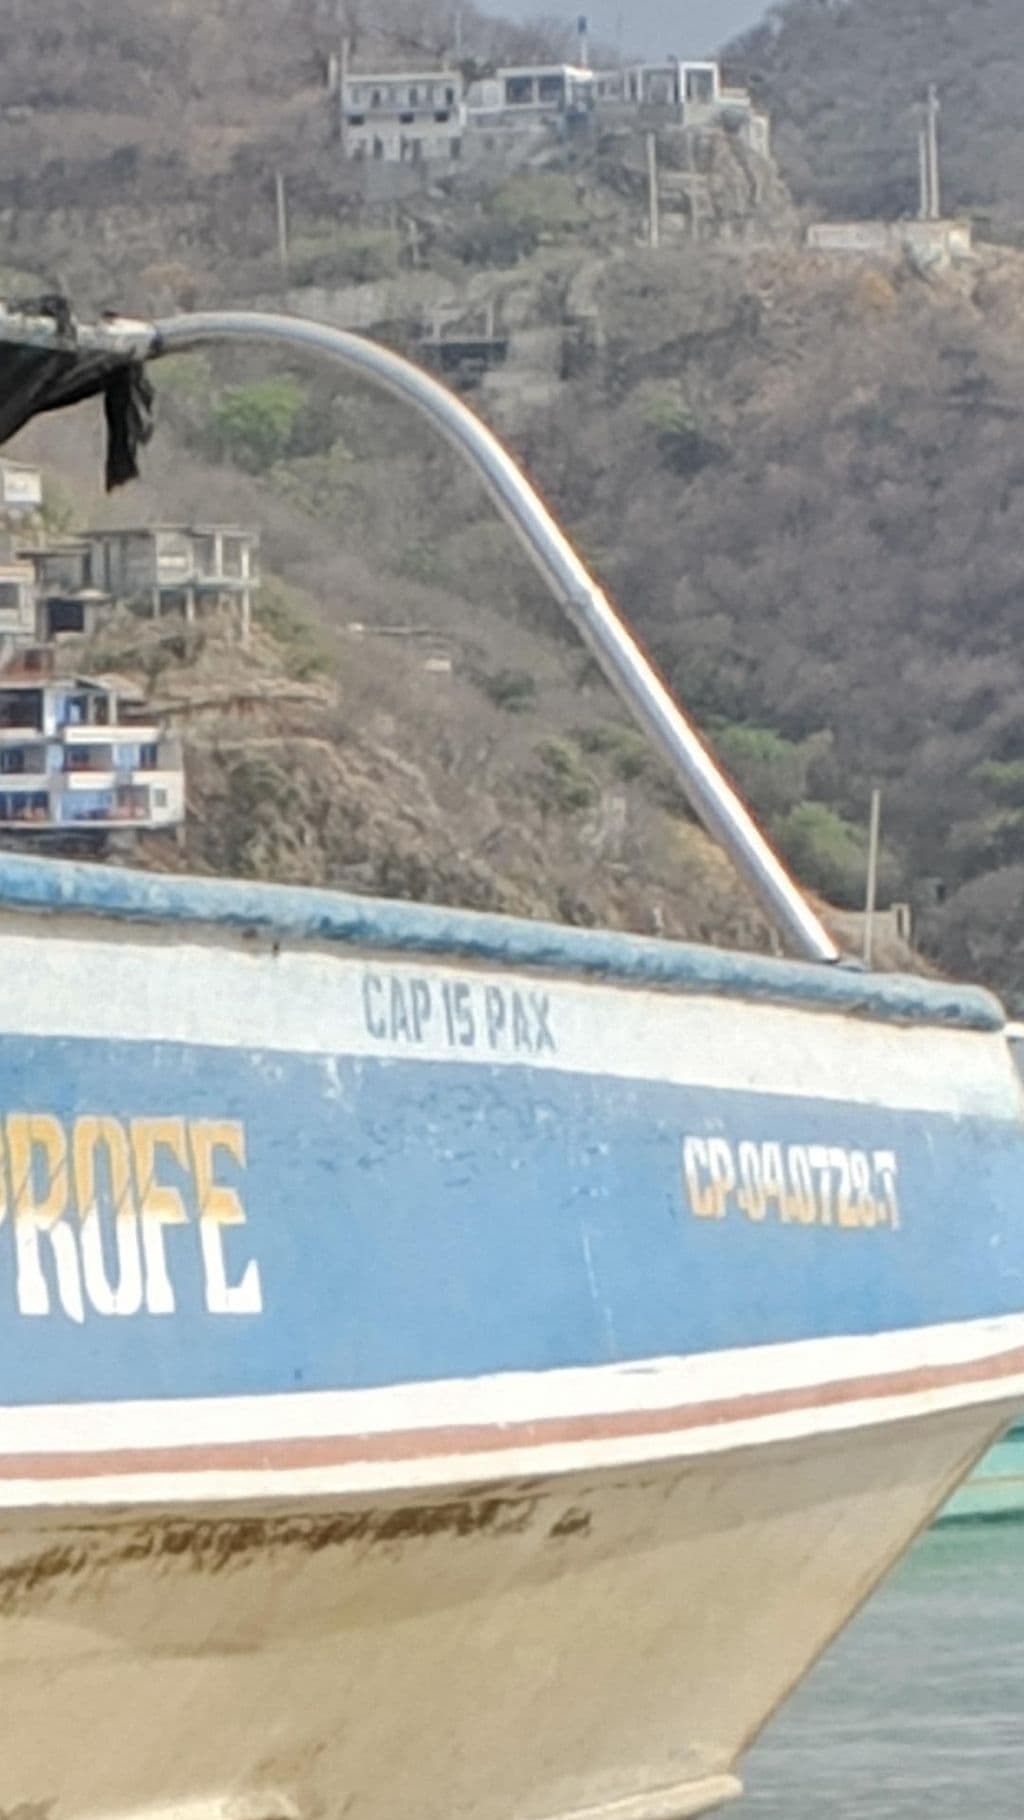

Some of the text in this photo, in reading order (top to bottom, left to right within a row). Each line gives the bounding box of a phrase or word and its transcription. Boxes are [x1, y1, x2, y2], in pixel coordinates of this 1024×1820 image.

[362, 973, 558, 1054] CAP 15 PAX
